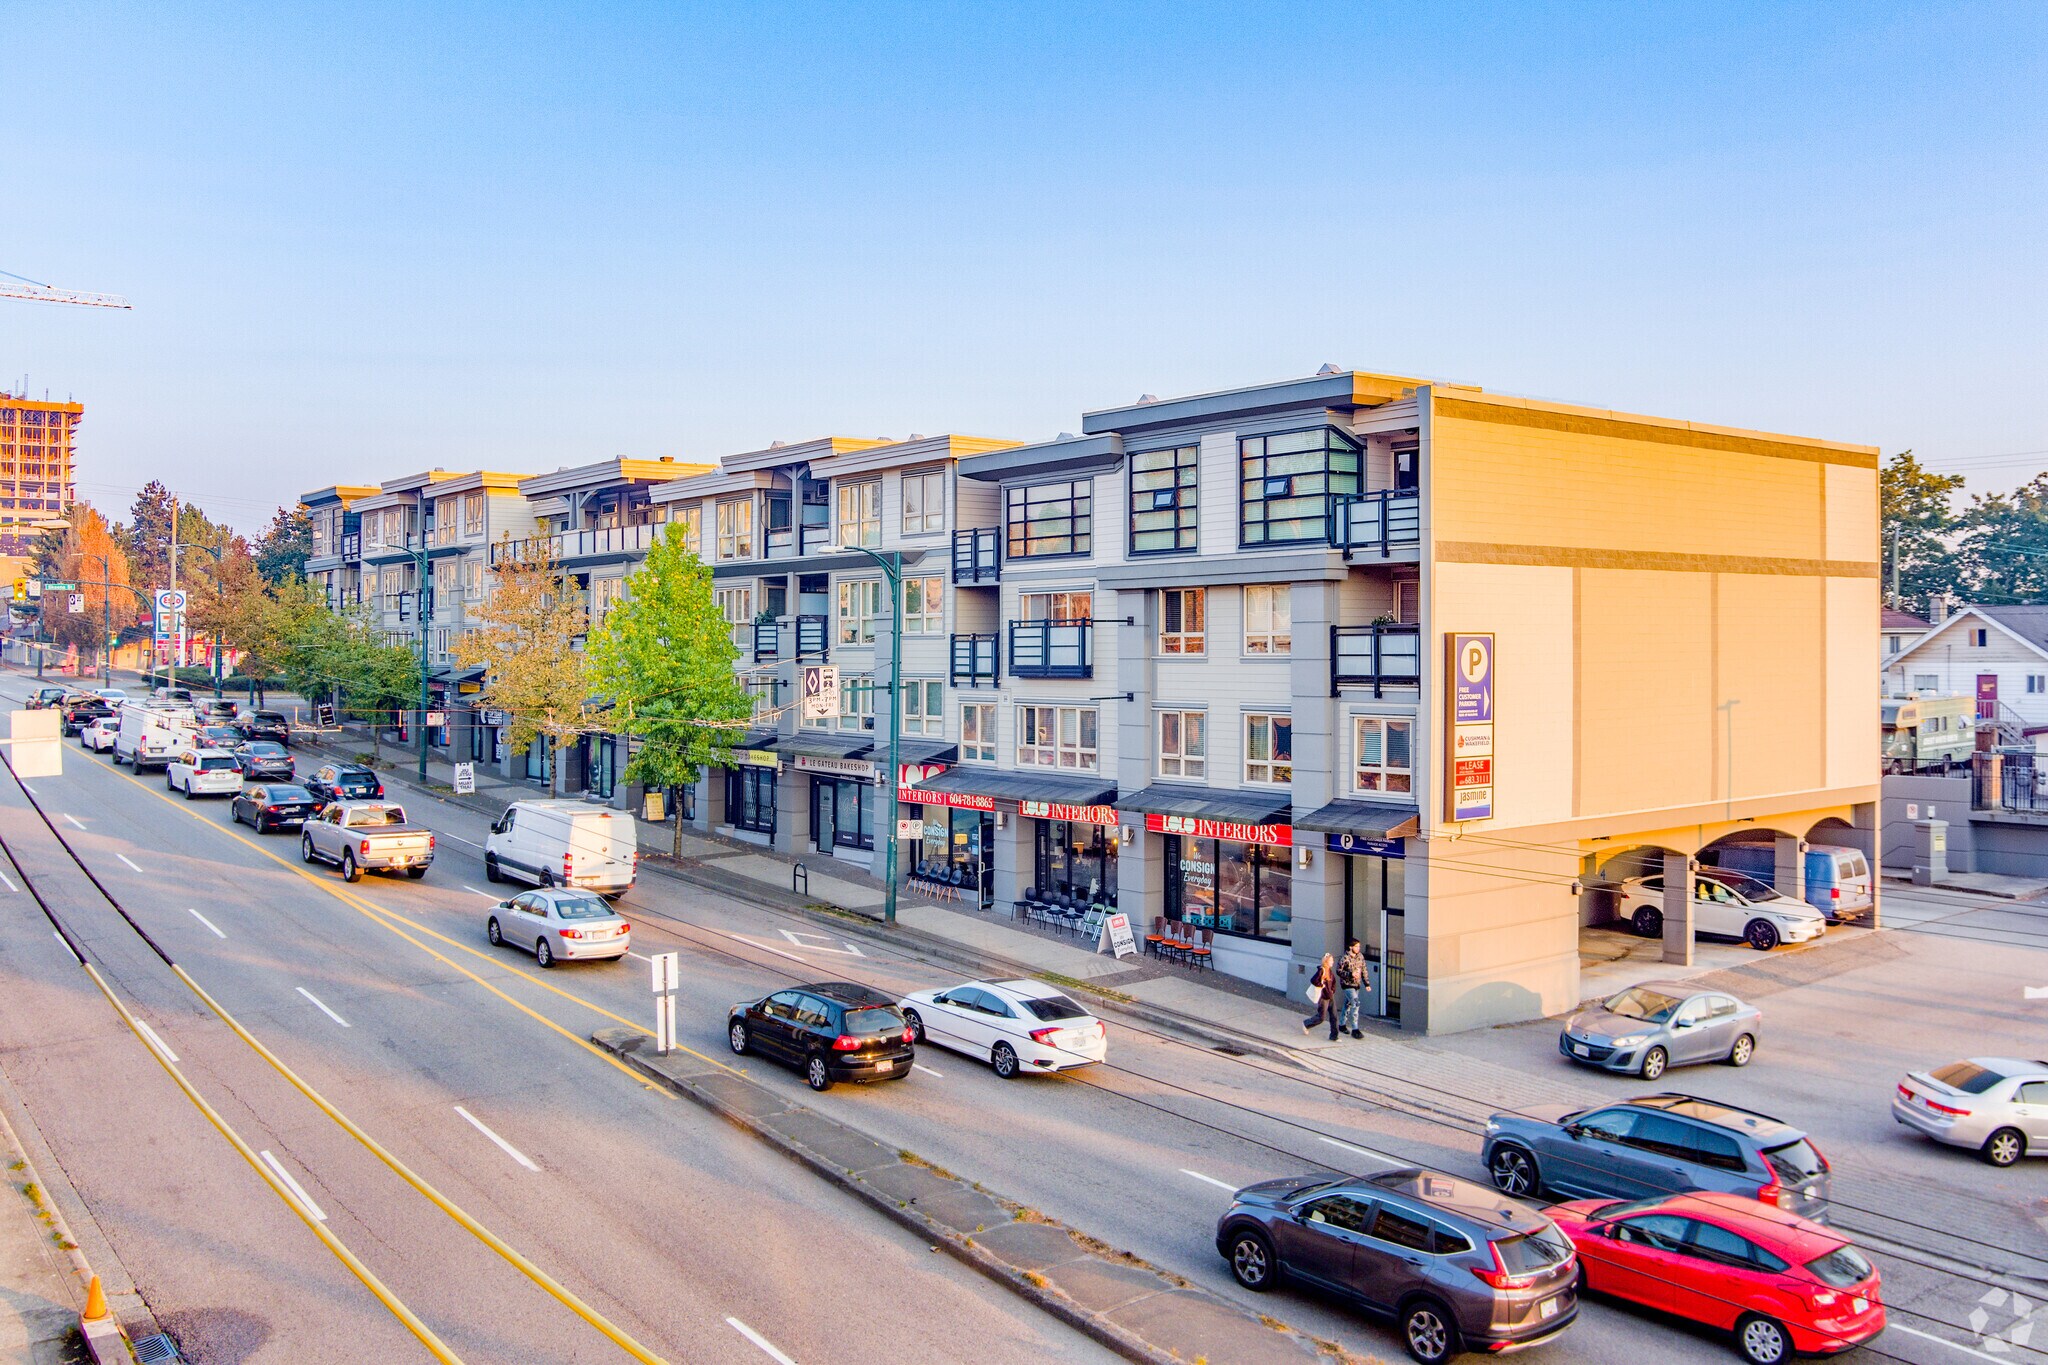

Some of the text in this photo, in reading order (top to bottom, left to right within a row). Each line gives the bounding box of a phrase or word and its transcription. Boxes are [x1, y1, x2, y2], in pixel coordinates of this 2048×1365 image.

[1468, 648, 1482, 676] P
[809, 759, 869, 772] LE GATEAU BAKESHOP
[1464, 760, 1484, 771] LEASE
[1464, 774, 1489, 785] 683.3111
[898, 789, 993, 809] INTERIORS 604-781-8865
[1022, 801, 1116, 825] LOLO INTERIORS
[923, 825, 949, 838] CONSIGN
[1162, 814, 1278, 843] LOLO INTERIORS
[1344, 835, 1351, 848] P
[1180, 859, 1215, 875] CONSIGN
[1183, 872, 1212, 888] Everyday
[1113, 938, 1134, 949] CONSIGN
